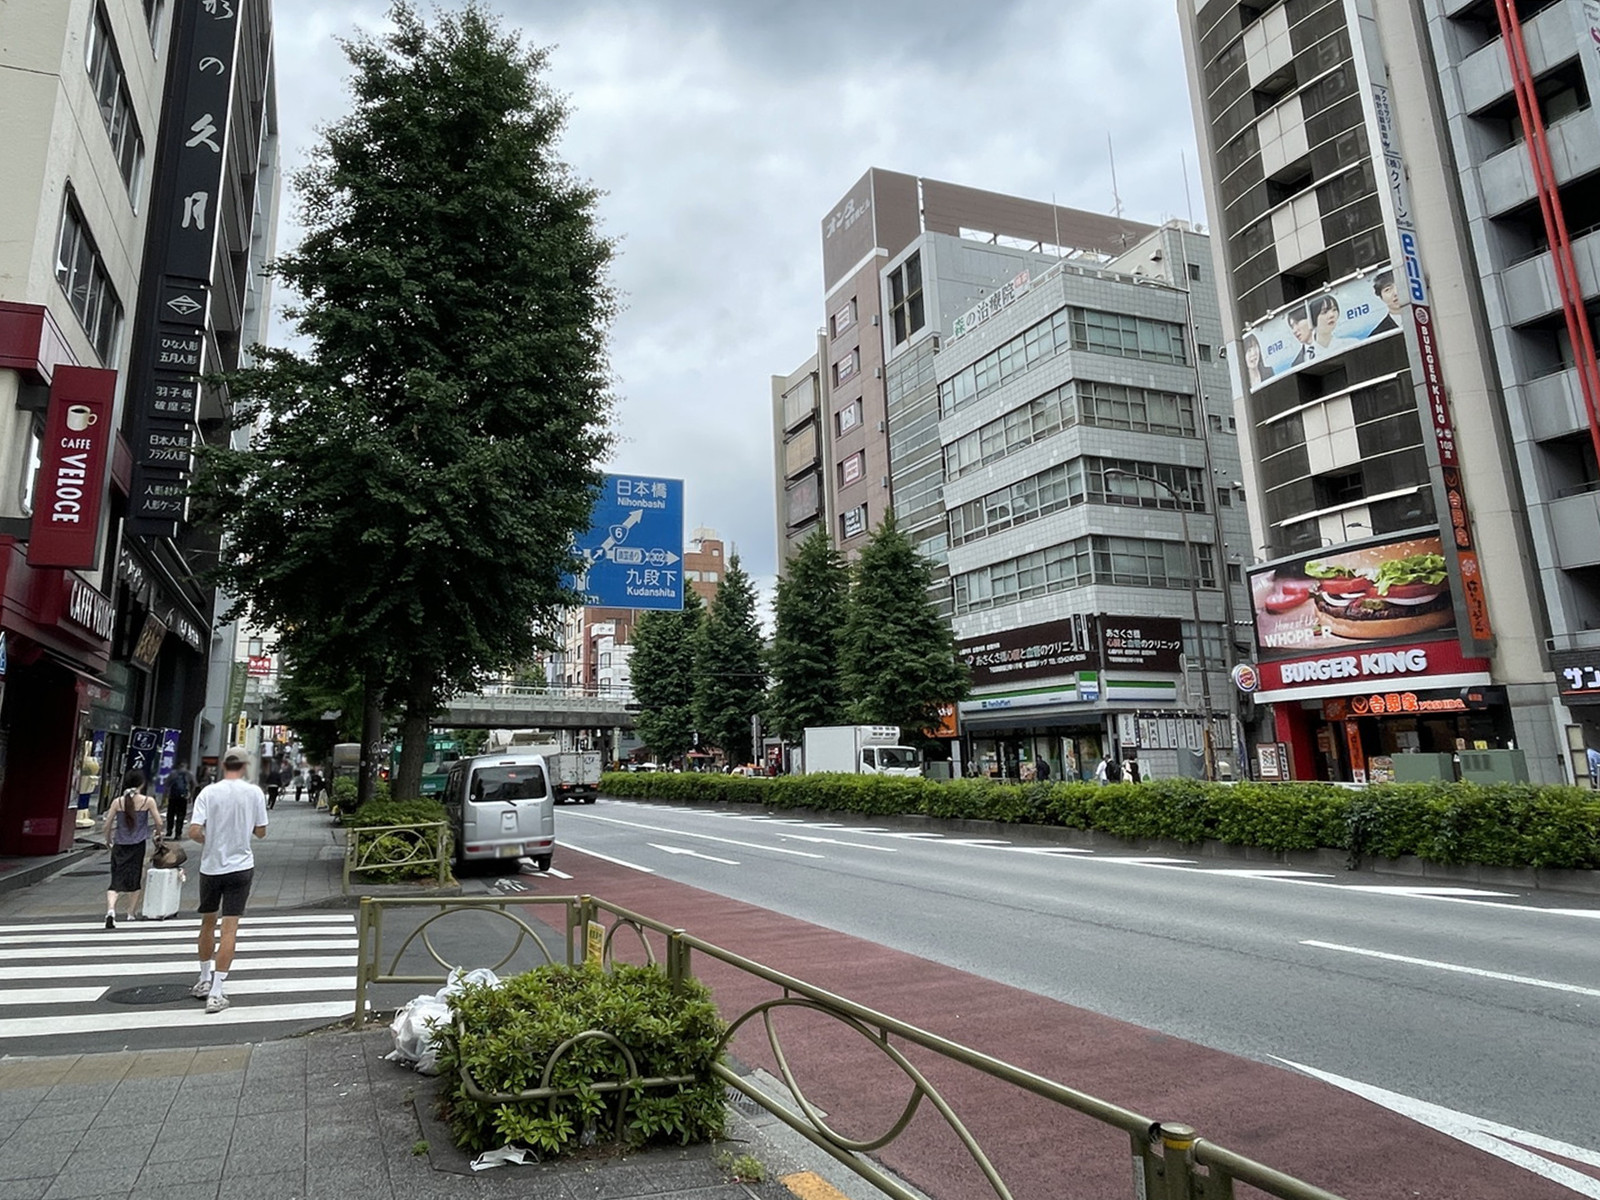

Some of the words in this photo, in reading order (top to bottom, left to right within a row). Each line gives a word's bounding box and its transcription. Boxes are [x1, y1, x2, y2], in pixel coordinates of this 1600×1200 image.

[1402, 233, 1424, 301] ena
[954, 282, 1015, 336] 森の治療院
[1346, 303, 1370, 320] ena
[161, 338, 199, 351] ひな人形
[1267, 340, 1284, 355] ena
[160, 351, 198, 365] 五月人形
[1421, 326, 1438, 383] BURGER
[1432, 385, 1446, 424] KING
[155, 385, 193, 399] 羽子板
[154, 400, 192, 413] 破魔弓
[61, 437, 91, 450] CAFFE
[150, 434, 188, 447] 日本人形
[149, 448, 188, 461] フランス人形
[52, 453, 88, 523] VELOCE
[617, 479, 667, 498] 日本橋
[142, 499, 182, 512] 人形ケース
[617, 496, 666, 509] Nihonbashi
[615, 527, 623, 539] 6
[626, 568, 678, 587] 九段下
[626, 586, 676, 598] Kudanshita
[1264, 625, 1332, 648] WHOPPR
[1280, 656, 1360, 684] BURGER
[1360, 649, 1428, 675] KING
[1369, 691, 1419, 714] 吉野家
